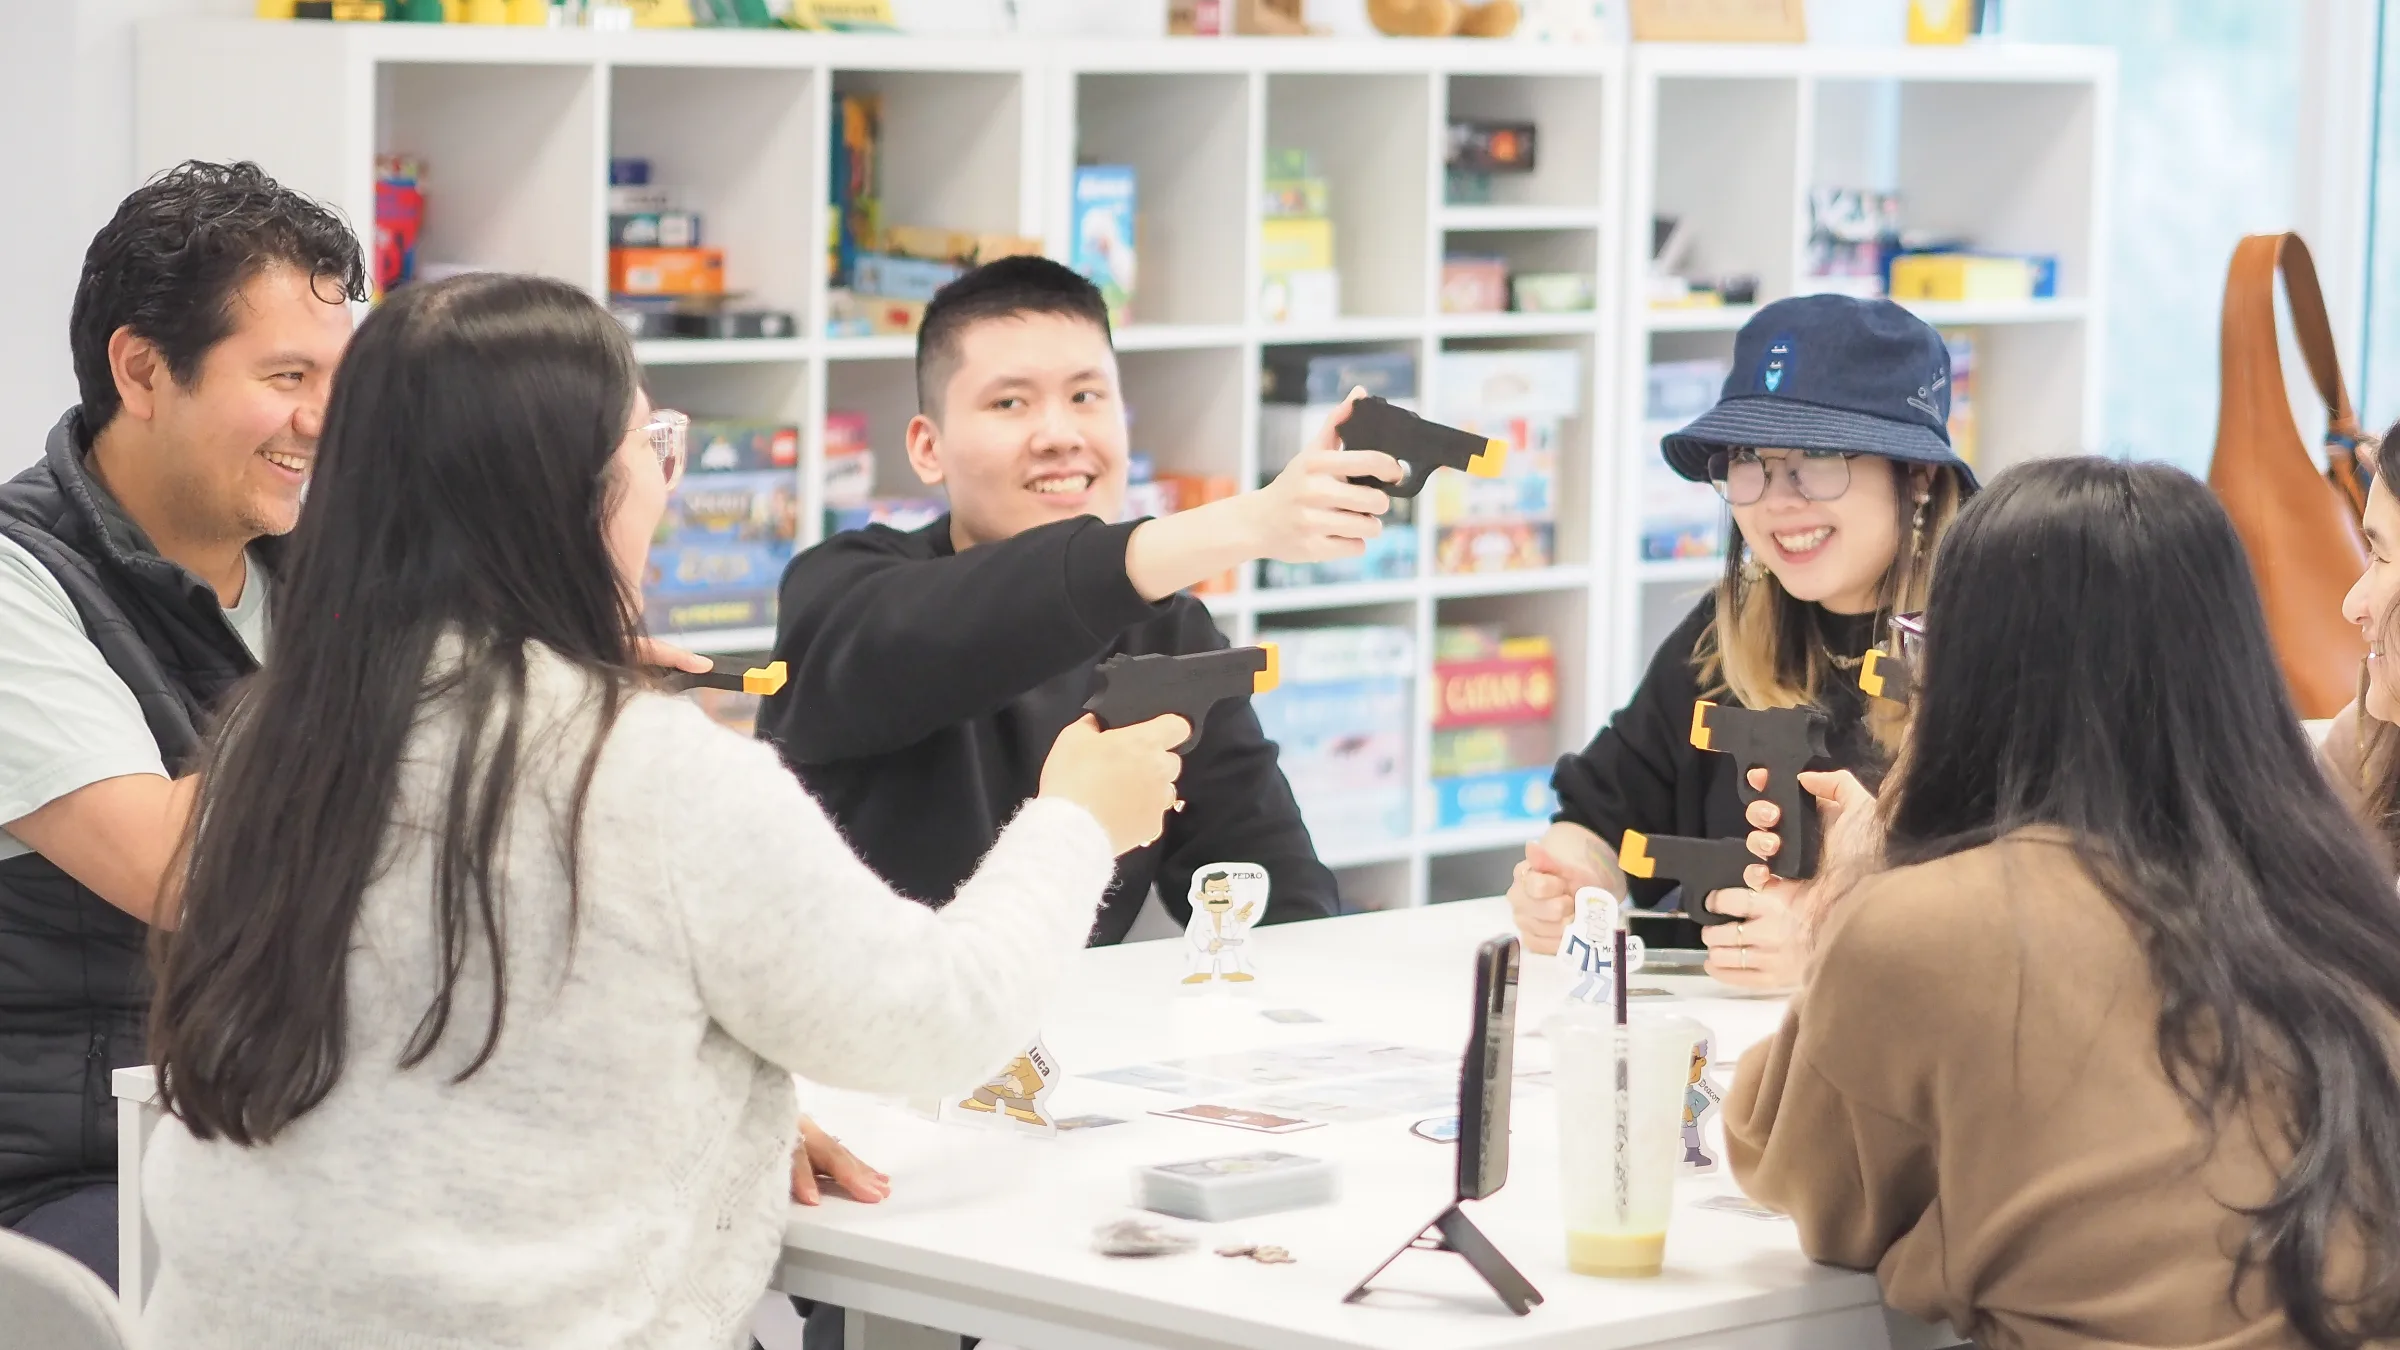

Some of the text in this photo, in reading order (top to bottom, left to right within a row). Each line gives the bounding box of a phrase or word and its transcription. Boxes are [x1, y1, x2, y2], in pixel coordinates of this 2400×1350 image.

[1232, 872, 1263, 880] PEDRO
[1028, 1046, 1050, 1077] Luca
[1698, 1078, 1720, 1104] Deacon
